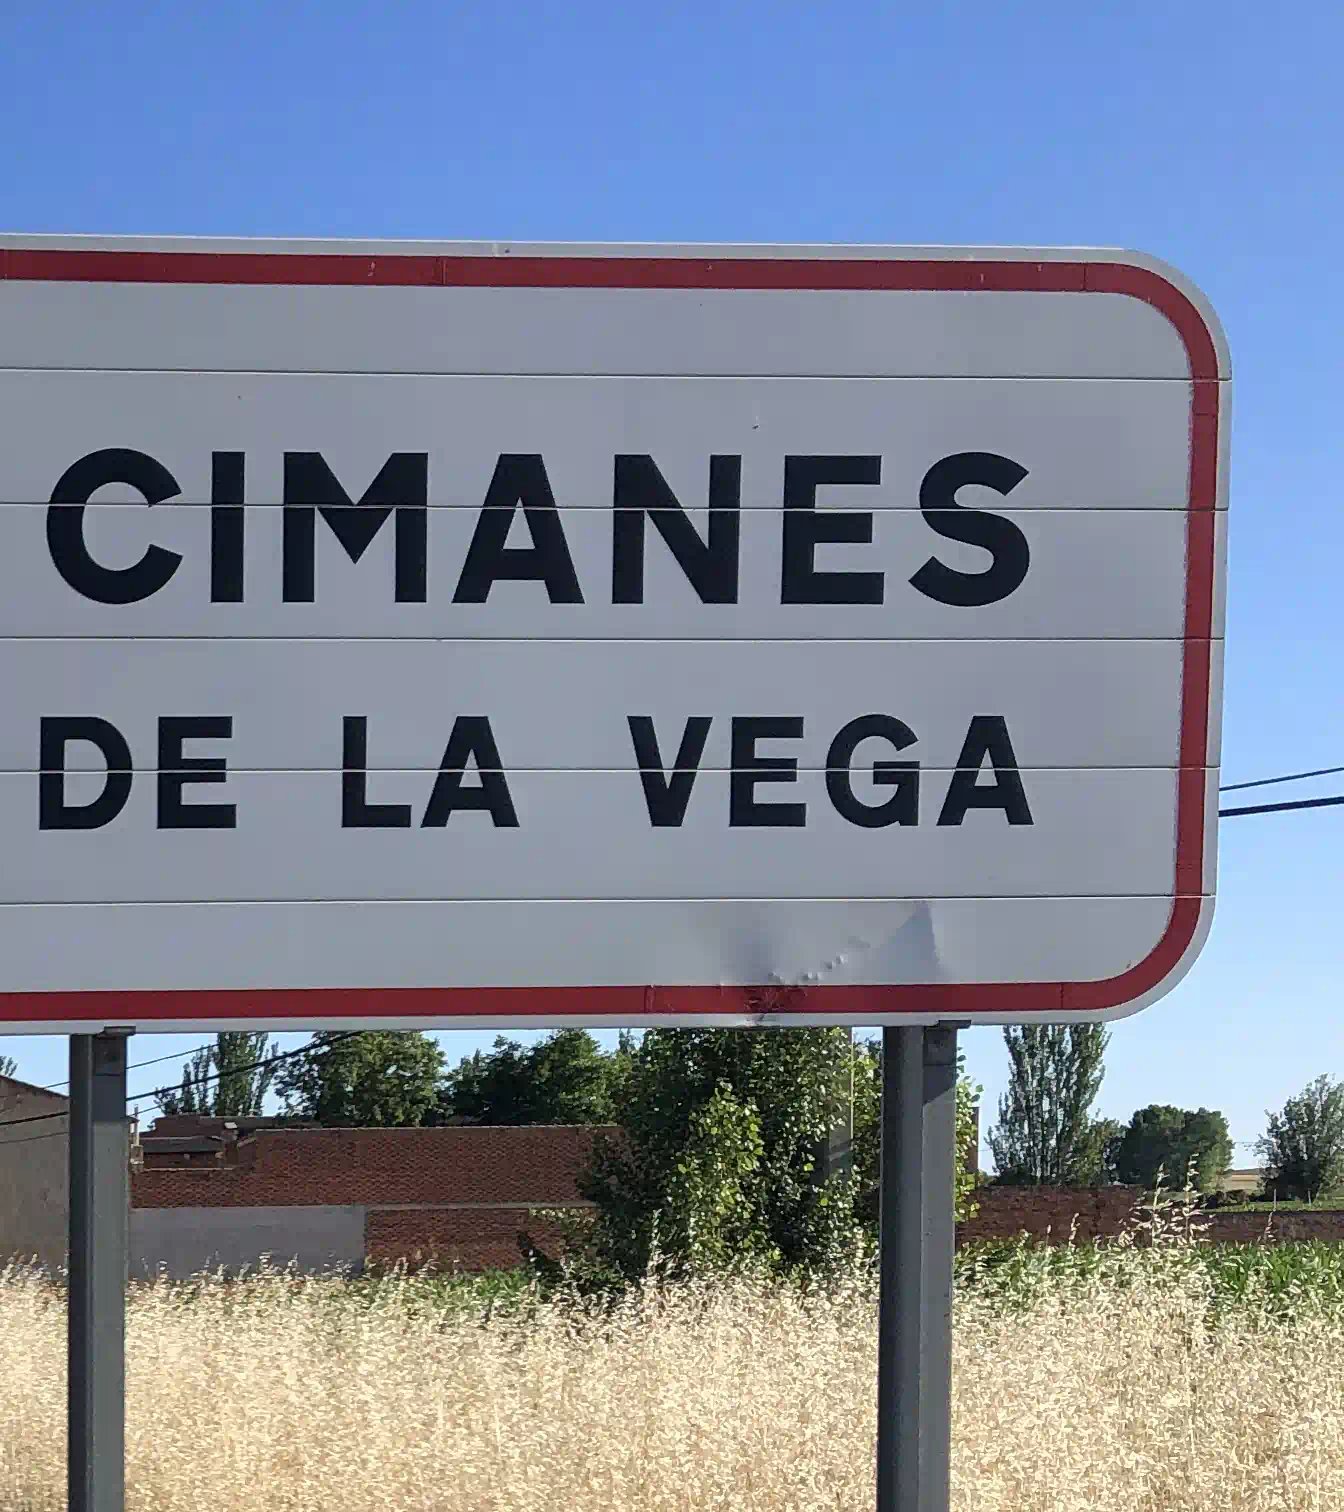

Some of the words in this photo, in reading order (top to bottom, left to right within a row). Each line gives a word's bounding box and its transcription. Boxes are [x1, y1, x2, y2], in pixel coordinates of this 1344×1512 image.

[46, 447, 1031, 608] CIMANES
[39, 715, 237, 832] DE
[341, 715, 520, 830] LA
[627, 714, 1035, 830] VEGA
